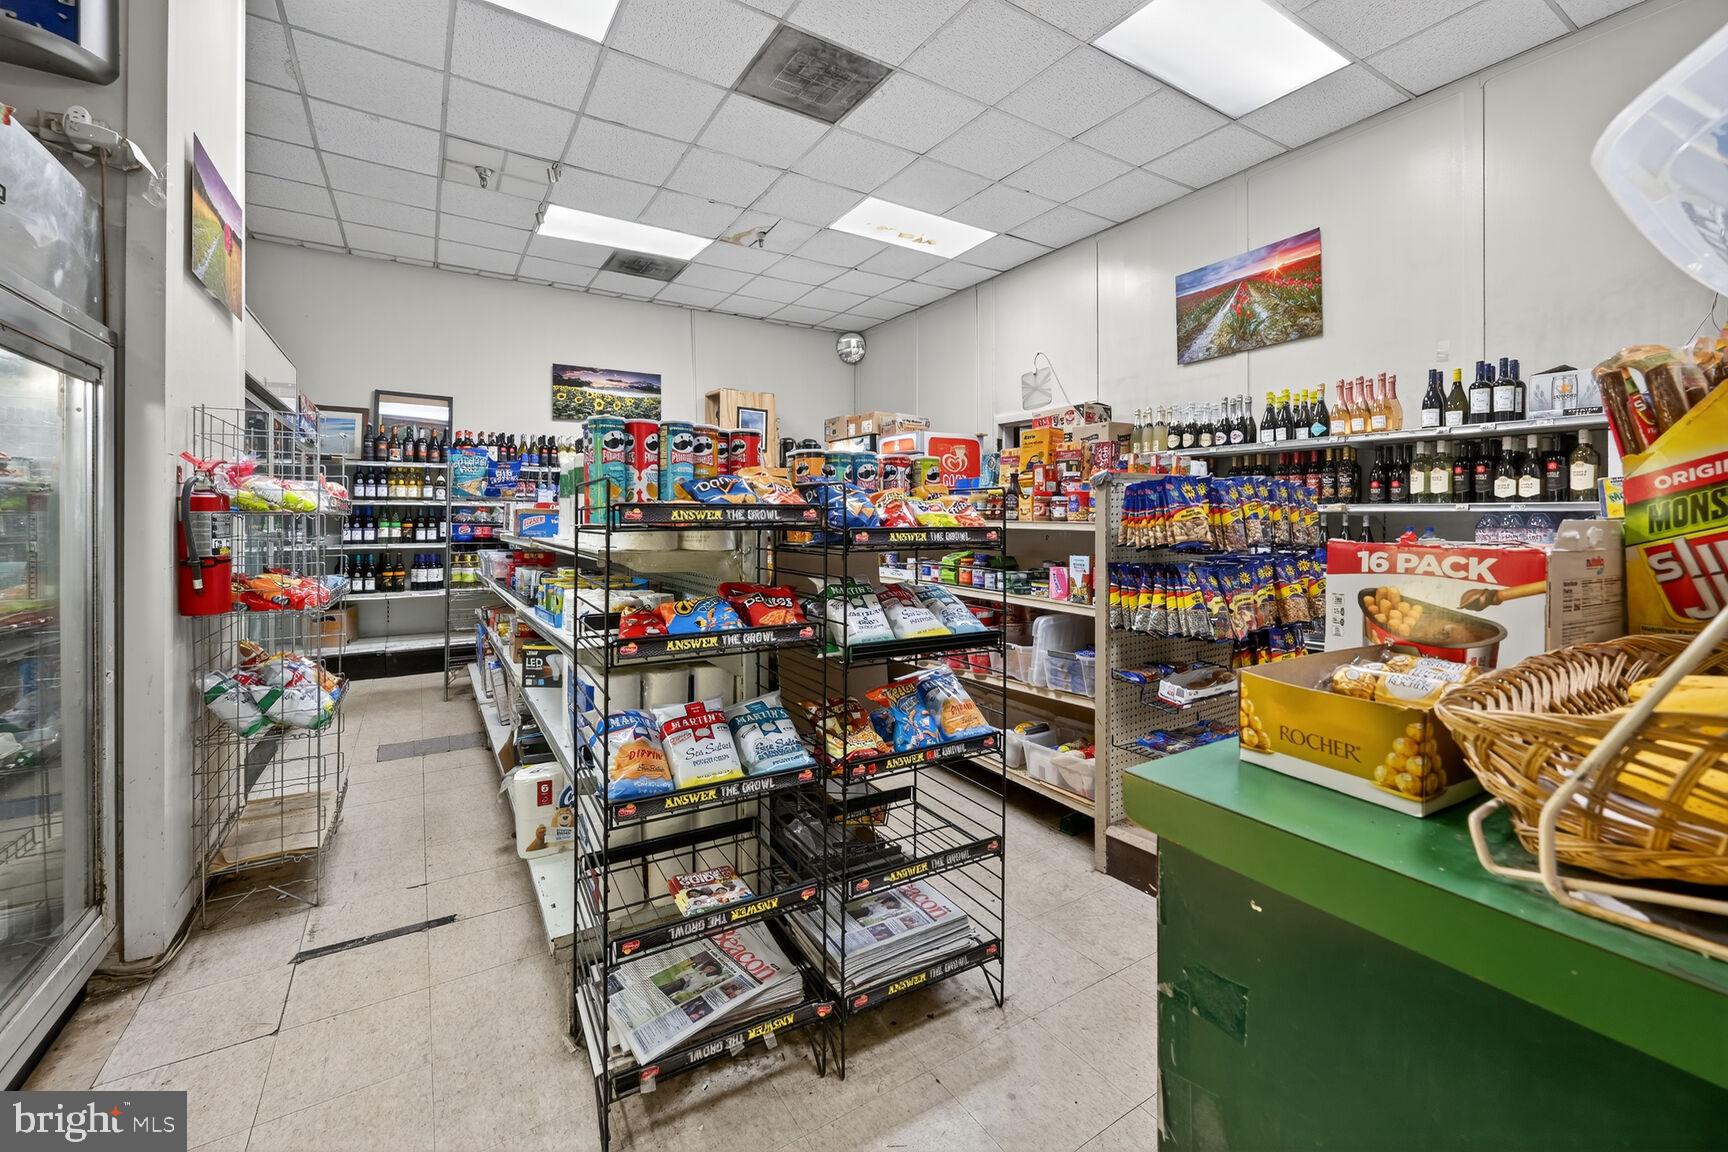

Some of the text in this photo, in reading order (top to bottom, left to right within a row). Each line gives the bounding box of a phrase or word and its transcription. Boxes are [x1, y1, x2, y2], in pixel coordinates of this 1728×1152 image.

[670, 509, 780, 521] ANSWER THE GROWL
[1357, 551, 1498, 584] 16 PACK
[666, 631, 777, 652] ANSWER THE GROWL
[526, 657, 543, 668] LED
[671, 713, 726, 731] MARTIN'S
[736, 709, 790, 726] MARTIN'S
[1280, 725, 1360, 763] ROCHER
[664, 777, 776, 809] ANSWER THE GROWL
[889, 862, 929, 882] ANSWER
[668, 897, 779, 941] ANSWER THE GROWL
[887, 972, 928, 995] ANSWER
[688, 1013, 794, 1063] ANSWER THE GROWL
